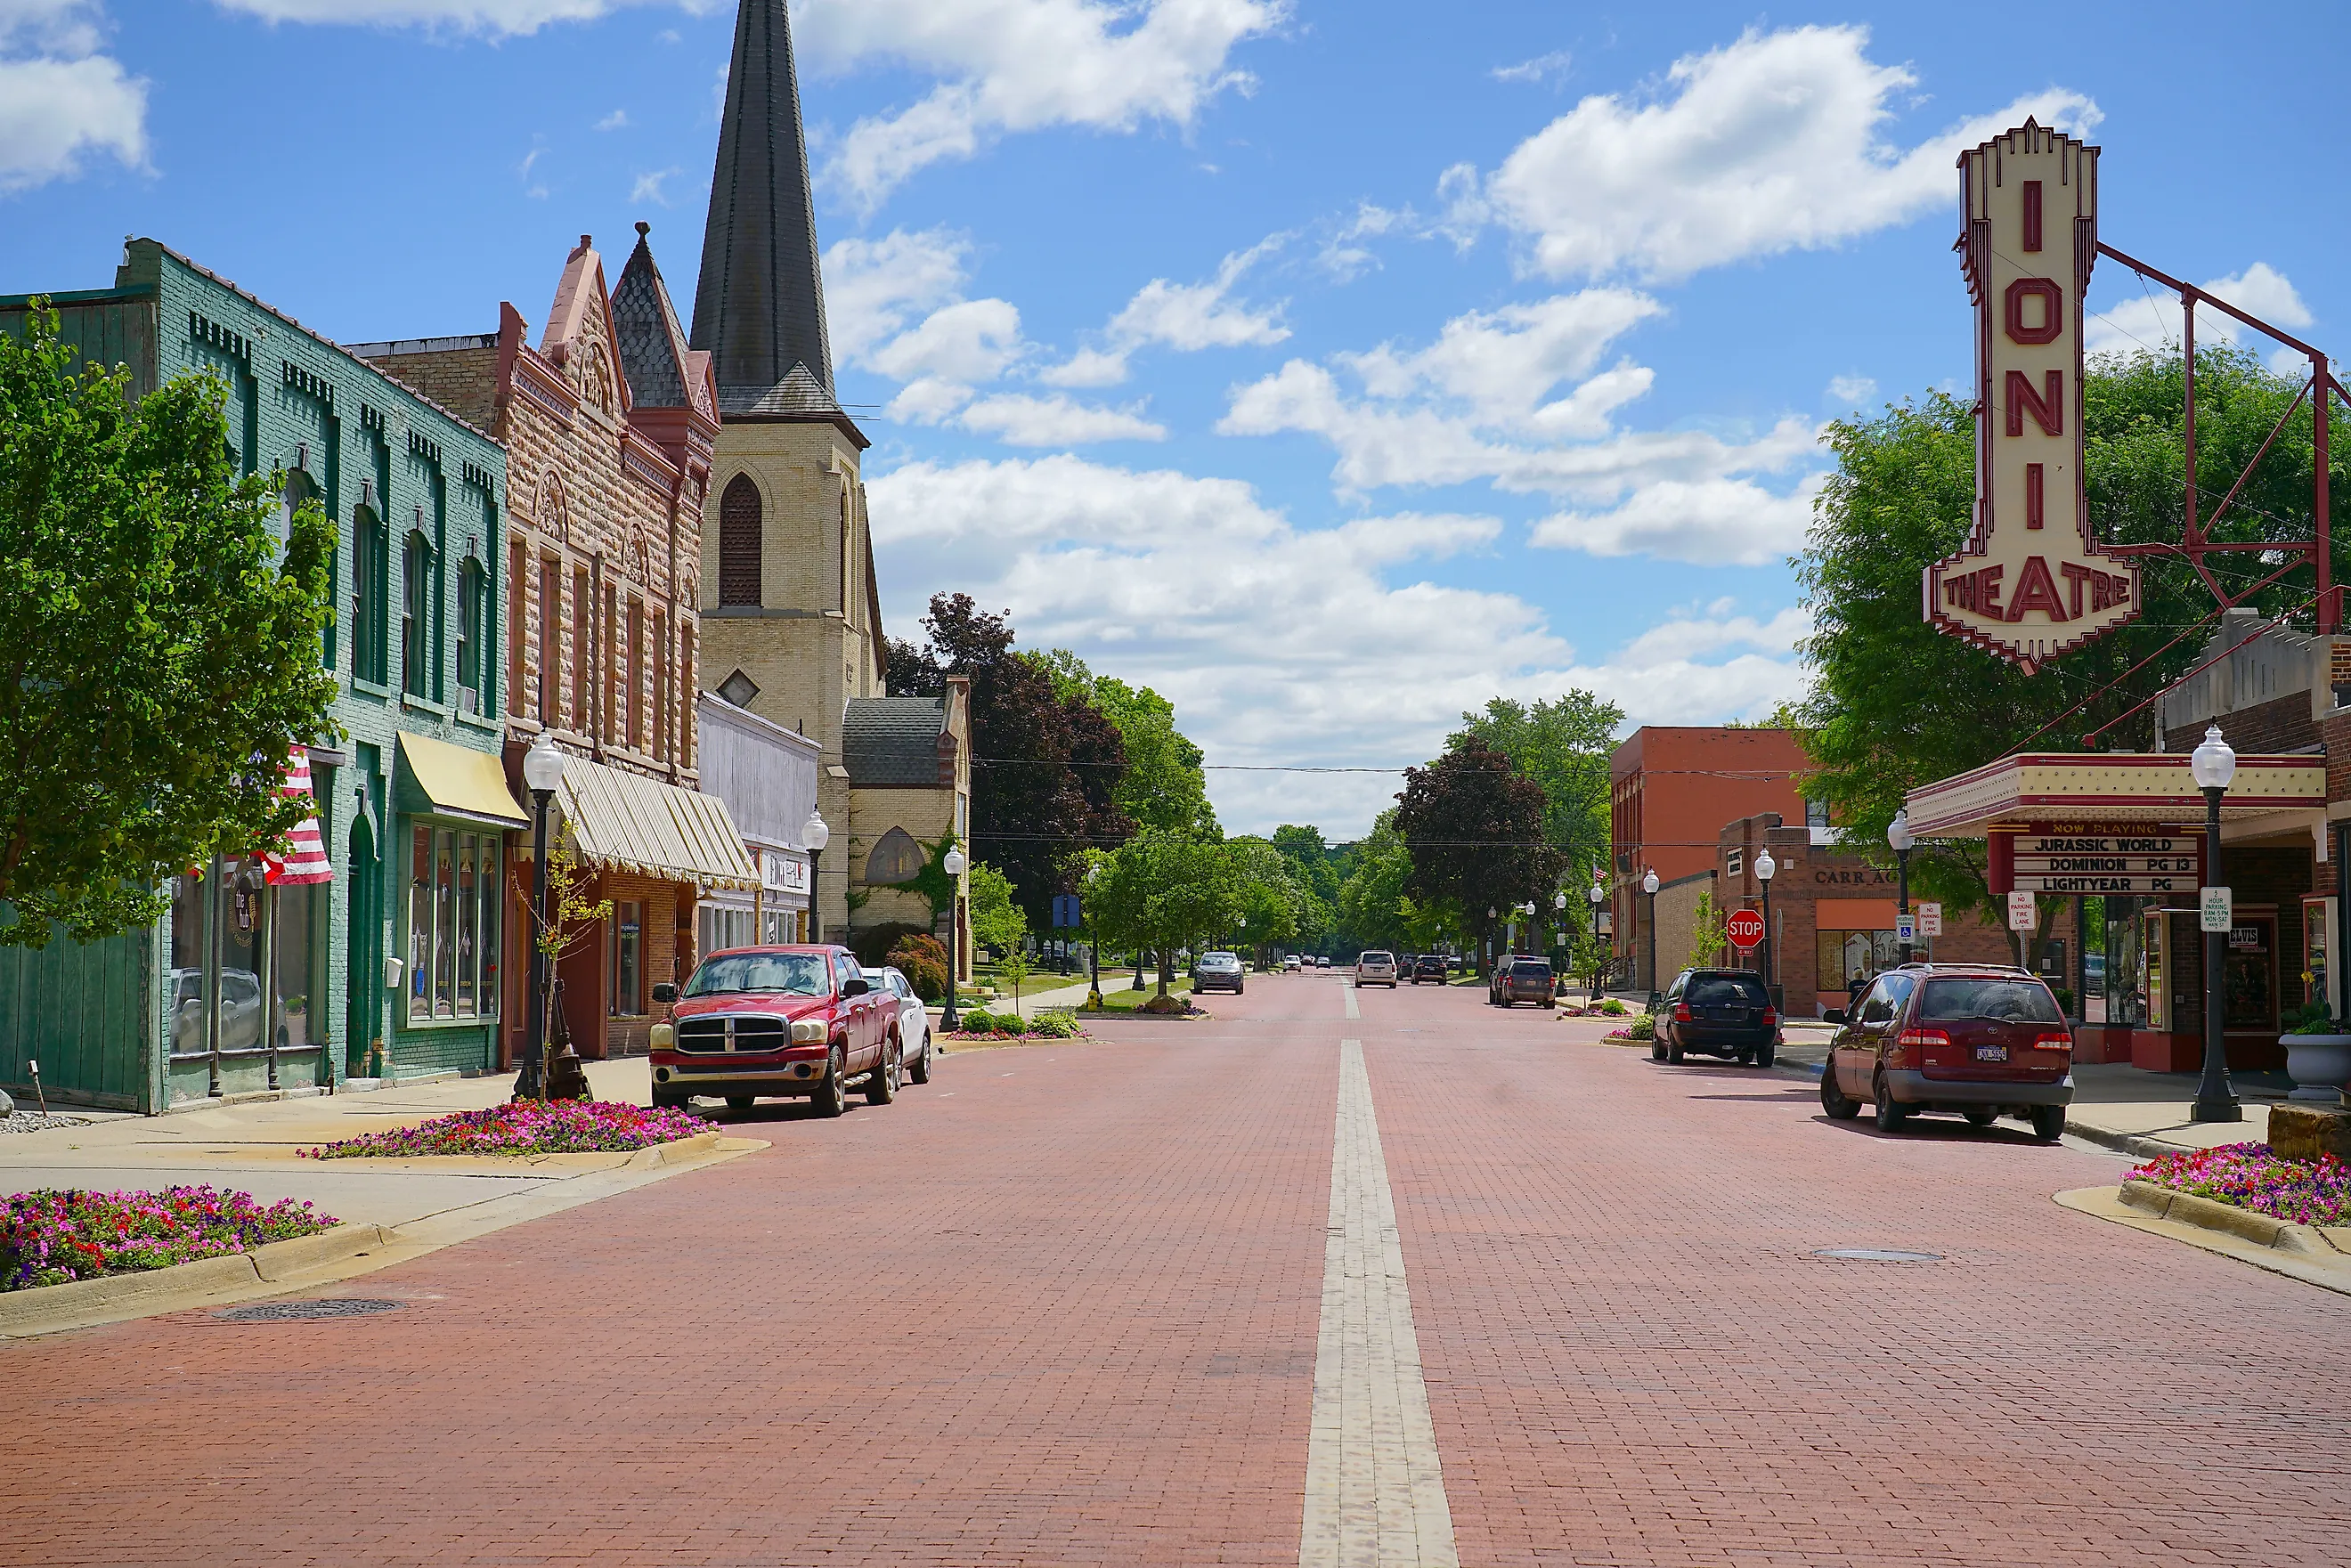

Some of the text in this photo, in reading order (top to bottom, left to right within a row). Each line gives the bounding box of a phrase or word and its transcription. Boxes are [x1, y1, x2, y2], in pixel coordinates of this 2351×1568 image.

[1943, 556, 2130, 622] THEATRE
[2053, 824, 2157, 833] NOW PLAYING
[2035, 839, 2172, 851] JURASSIC WORLD
[2049, 858, 2190, 871] DOMINION PG 13
[1815, 871, 1865, 883] CARR
[2043, 878, 2172, 891] LIGHTYEAR PG
[235, 889, 245, 909] the
[239, 908, 249, 928] hub
[1729, 922, 1762, 936] STOP
[2230, 929, 2257, 942] ELVIS
[1991, 1049, 2006, 1059] 5659
